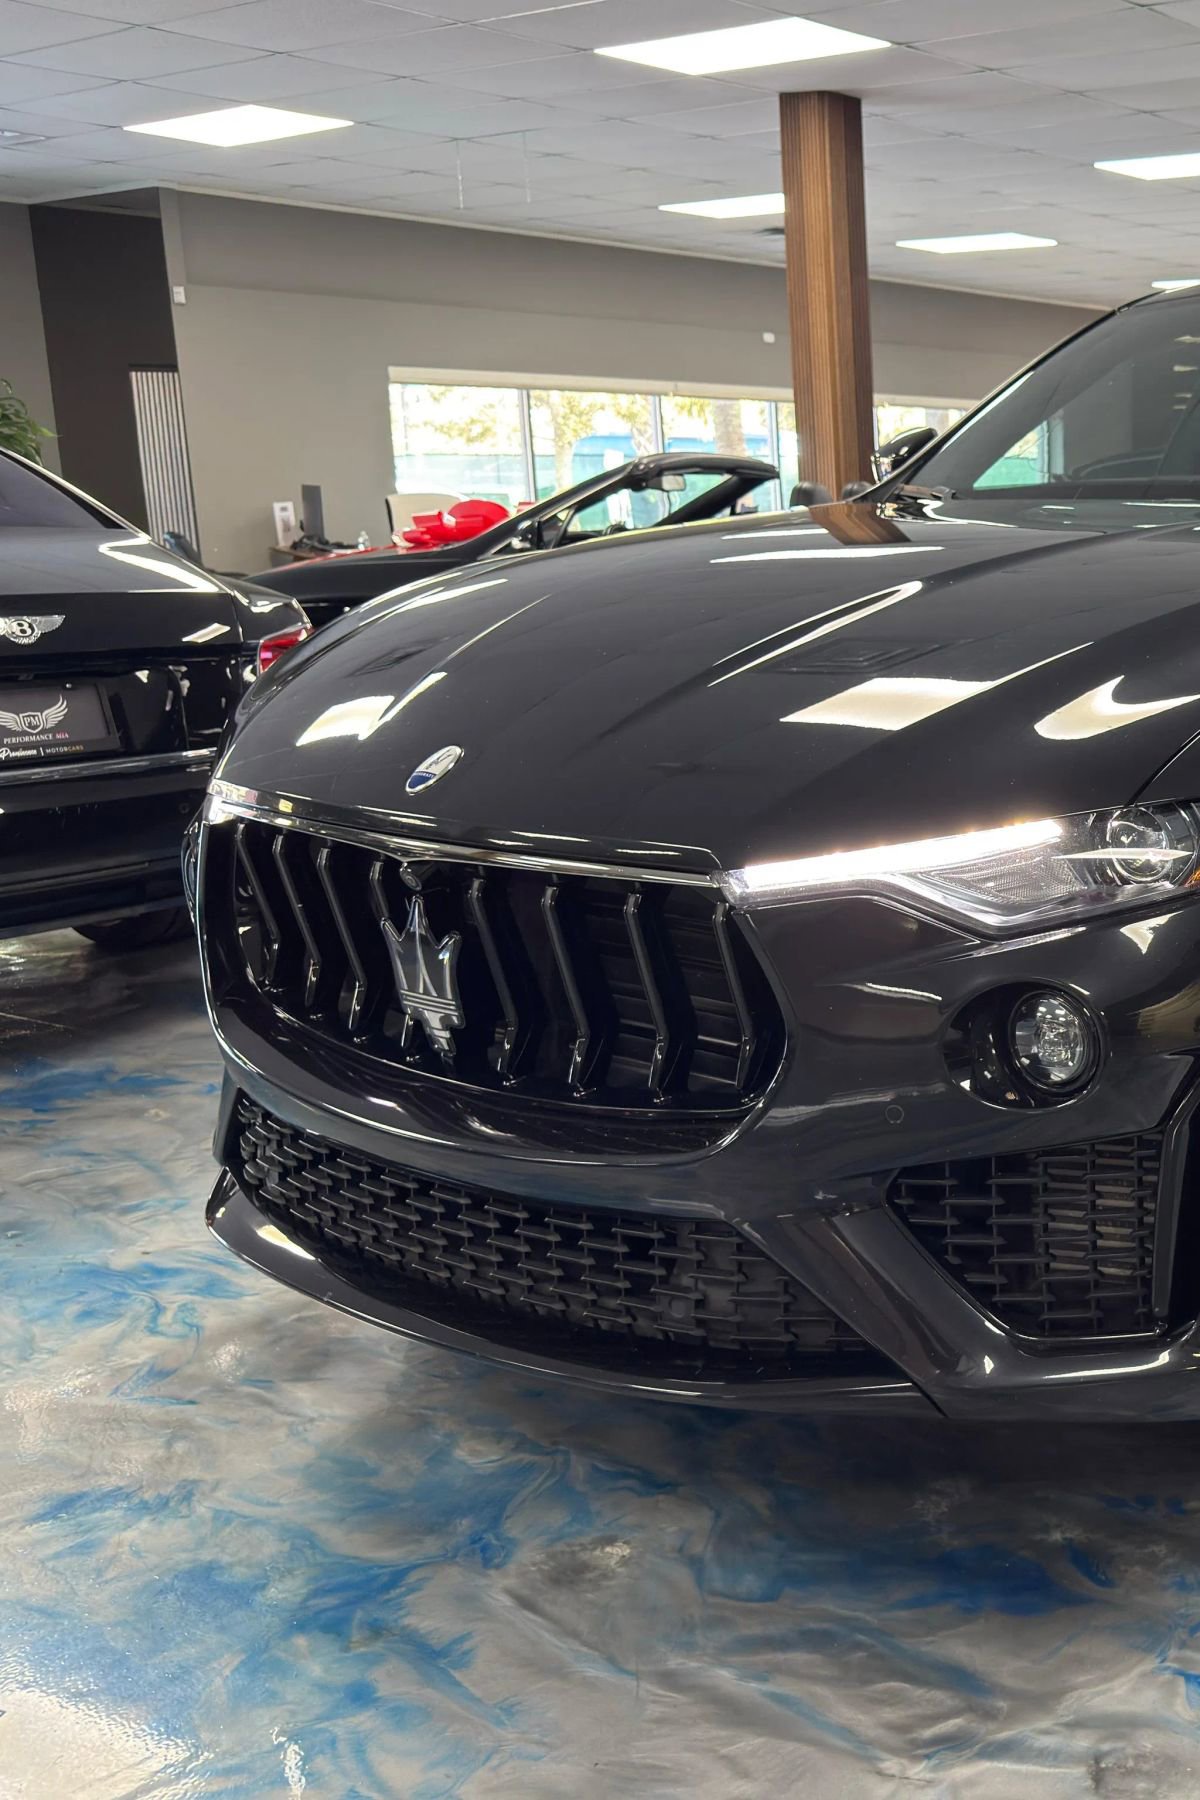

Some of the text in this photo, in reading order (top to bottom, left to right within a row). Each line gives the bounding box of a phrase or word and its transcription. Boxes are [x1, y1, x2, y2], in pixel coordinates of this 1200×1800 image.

[11, 620, 32, 637] B
[24, 716, 40, 727] PM
[3, 733, 53, 744] PERFORMANCE
[46, 745, 84, 754] MOTORCARS
